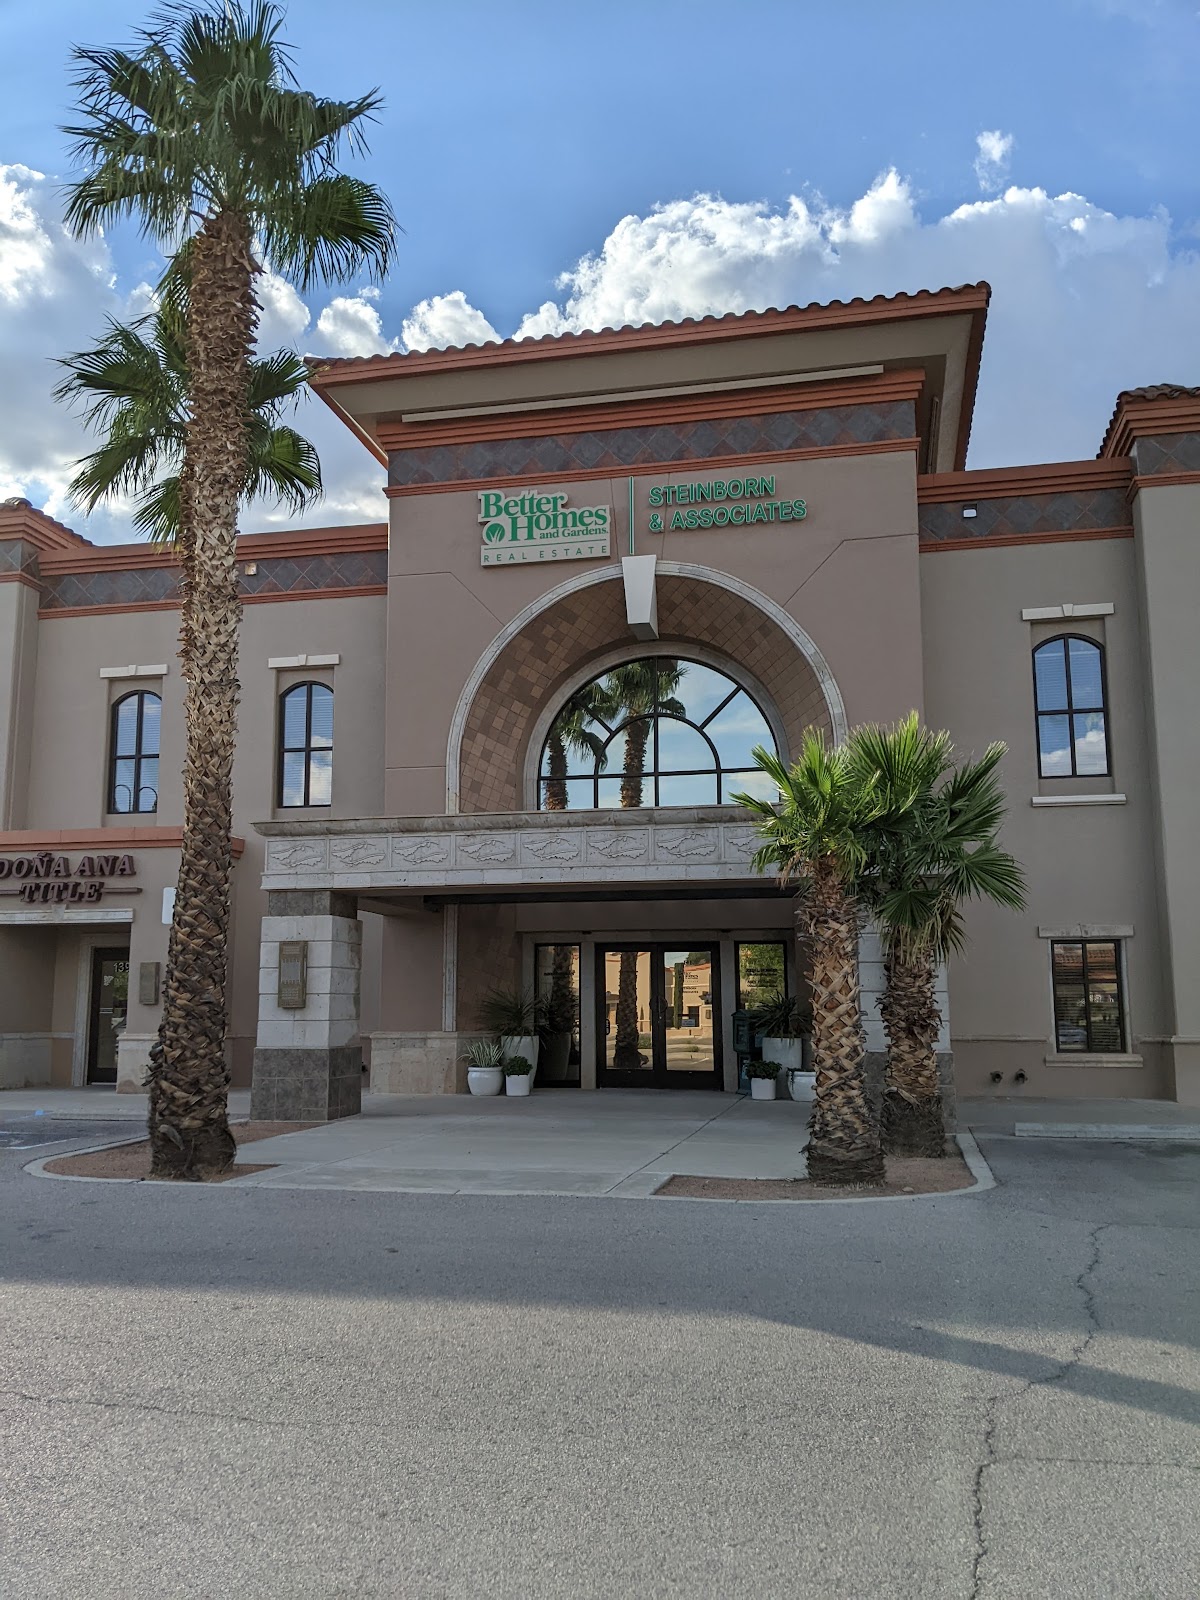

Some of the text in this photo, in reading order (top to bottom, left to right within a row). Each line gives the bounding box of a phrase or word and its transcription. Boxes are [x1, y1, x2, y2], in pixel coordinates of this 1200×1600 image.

[649, 475, 775, 507] STEINBORN
[481, 492, 565, 519] Better
[649, 499, 807, 533] & ASSOCIATES
[508, 508, 608, 542] Homes
[539, 531, 560, 540] and
[483, 545, 607, 563] REAL ESTATE
[74, 855, 136, 877] ANA
[20, 881, 104, 903] TITLE
